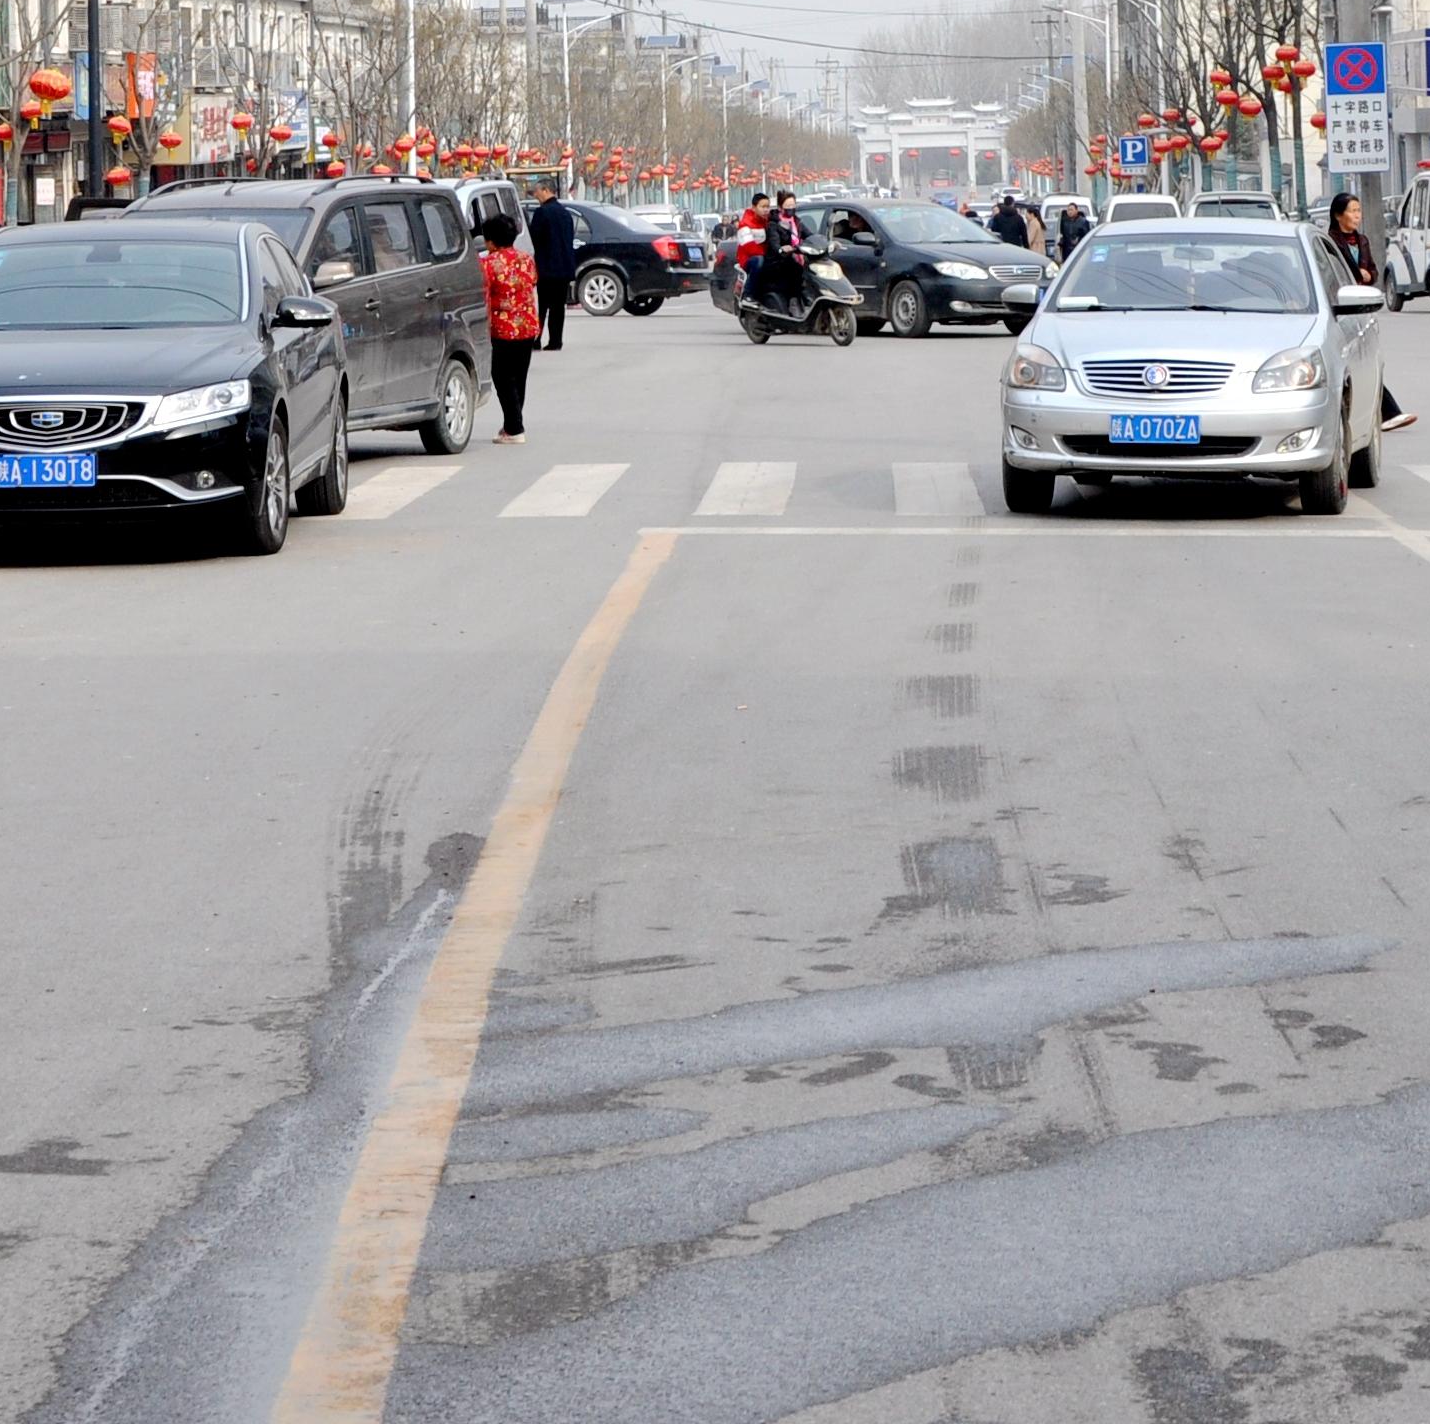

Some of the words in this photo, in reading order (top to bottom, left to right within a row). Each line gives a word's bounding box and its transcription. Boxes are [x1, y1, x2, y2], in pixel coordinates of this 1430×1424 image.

[1331, 100, 1382, 114] 十字路口
[1332, 119, 1384, 134] 严禁停车
[1124, 140, 1144, 162] P
[1332, 138, 1384, 154] 违者拖移
